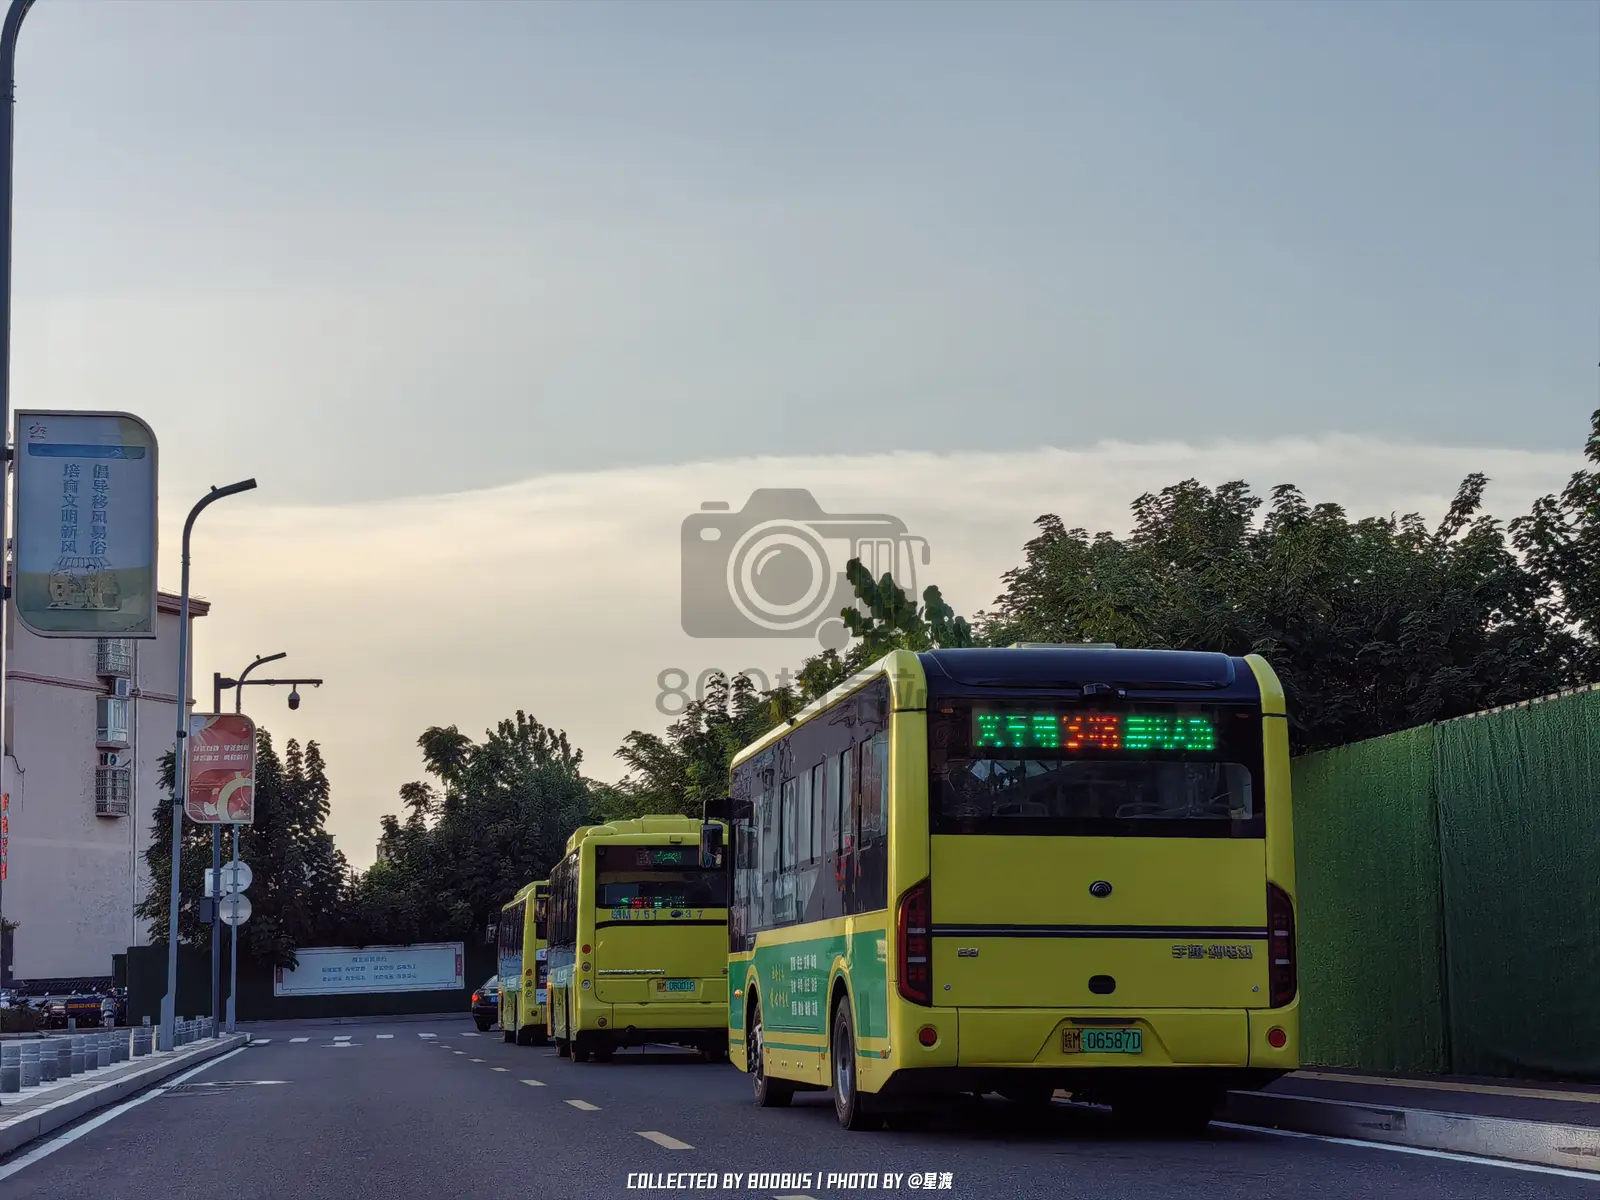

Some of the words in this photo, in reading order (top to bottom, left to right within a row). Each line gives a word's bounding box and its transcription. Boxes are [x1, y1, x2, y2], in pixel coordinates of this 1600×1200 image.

[89, 463, 110, 555] 倡导移风易俗
